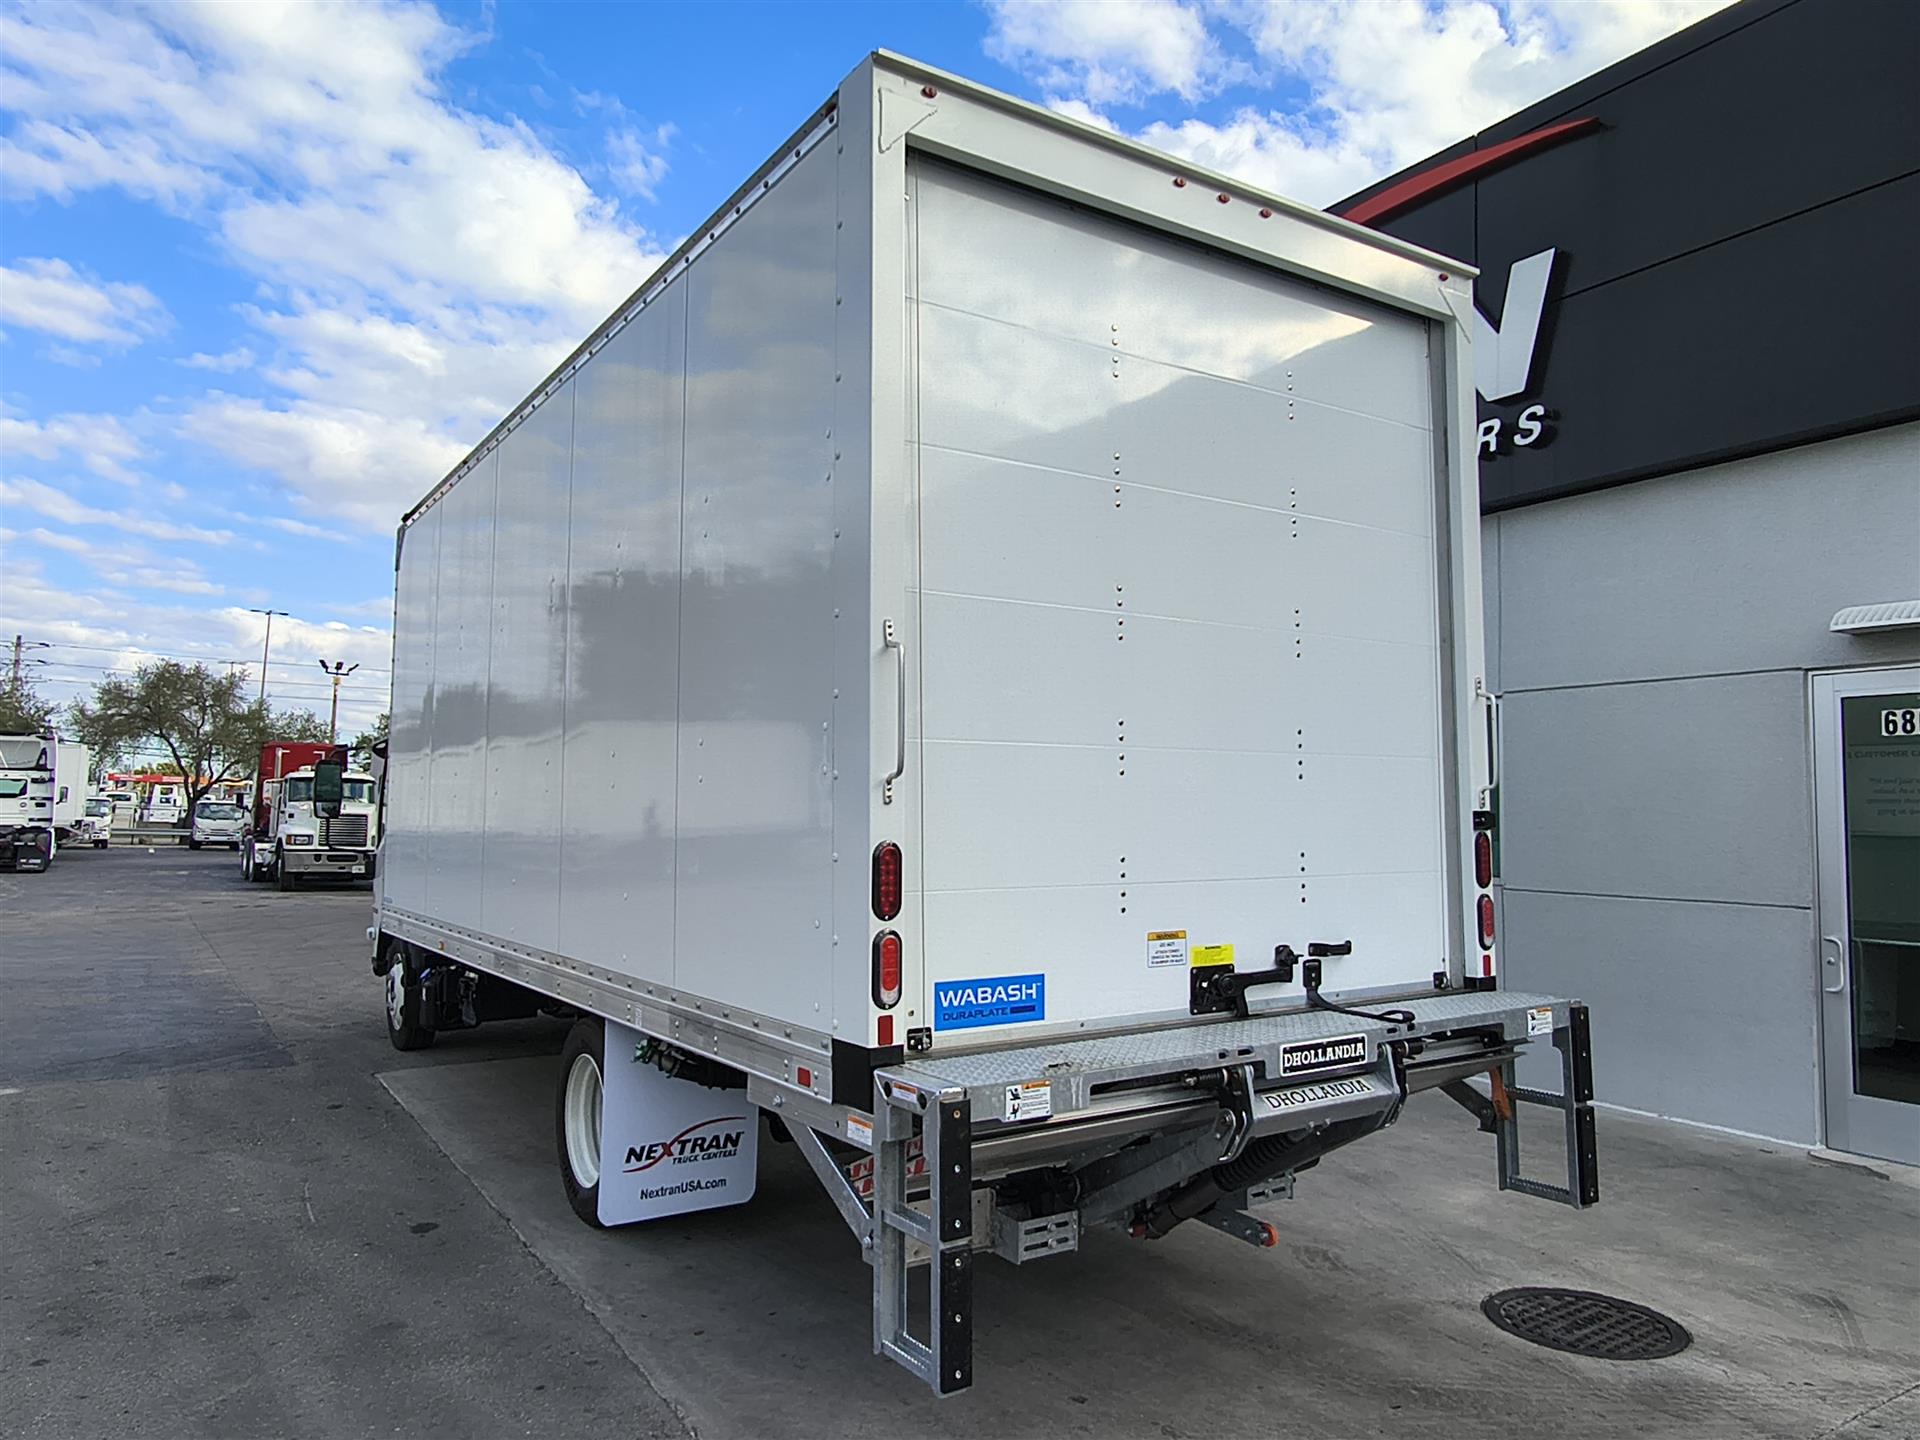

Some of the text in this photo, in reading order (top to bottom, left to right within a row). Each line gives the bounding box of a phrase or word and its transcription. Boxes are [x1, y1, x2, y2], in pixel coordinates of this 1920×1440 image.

[1884, 709, 1916, 735] 68
[939, 983, 1037, 1008] WABASH
[943, 1007, 1009, 1021] DURAPLATE
[1283, 1042, 1365, 1068] DHOLLANDIA
[1264, 1079, 1371, 1109] DHOLLANDIA
[624, 1131, 742, 1164] NEXTRAN
[672, 1148, 738, 1165] TRUCK CENTERS
[640, 1178, 727, 1200] NextranUSA.com
